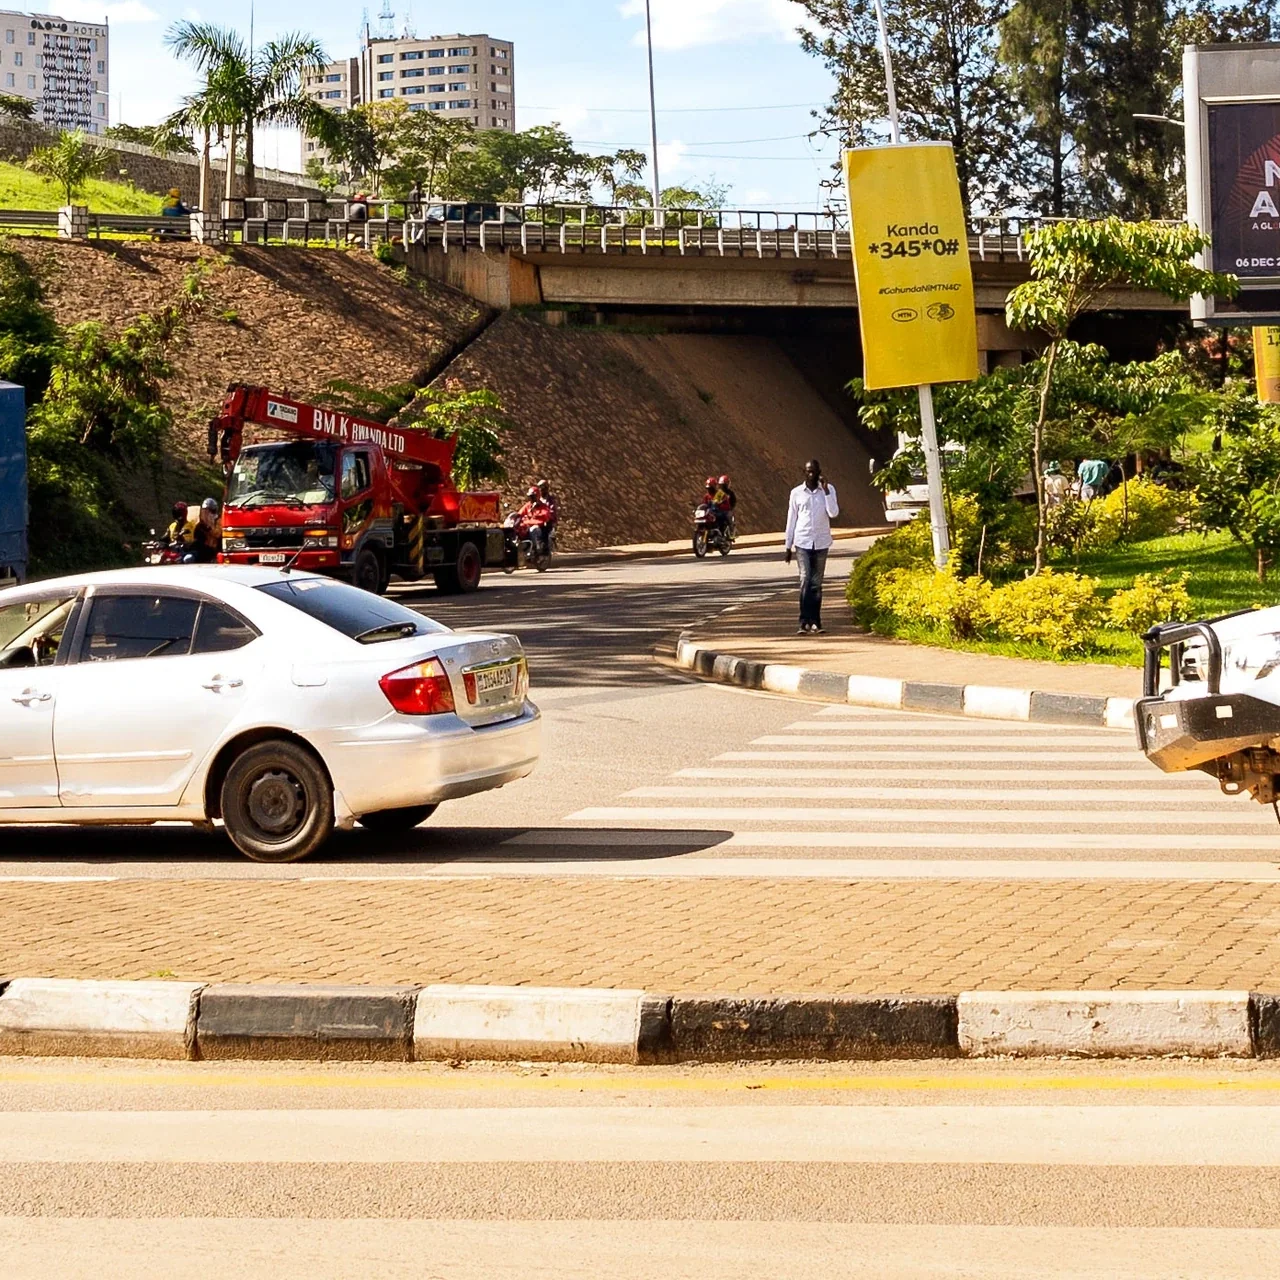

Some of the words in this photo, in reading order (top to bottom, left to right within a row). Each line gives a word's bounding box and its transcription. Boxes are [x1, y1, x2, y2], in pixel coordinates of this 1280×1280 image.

[74, 26, 106, 37] HOTEL
[887, 222, 939, 237] Kanda
[1236, 258, 1250, 267] 06
[1251, 258, 1274, 267] DEC
[352, 423, 387, 447] RWANDA
[388, 432, 405, 452] LTD
